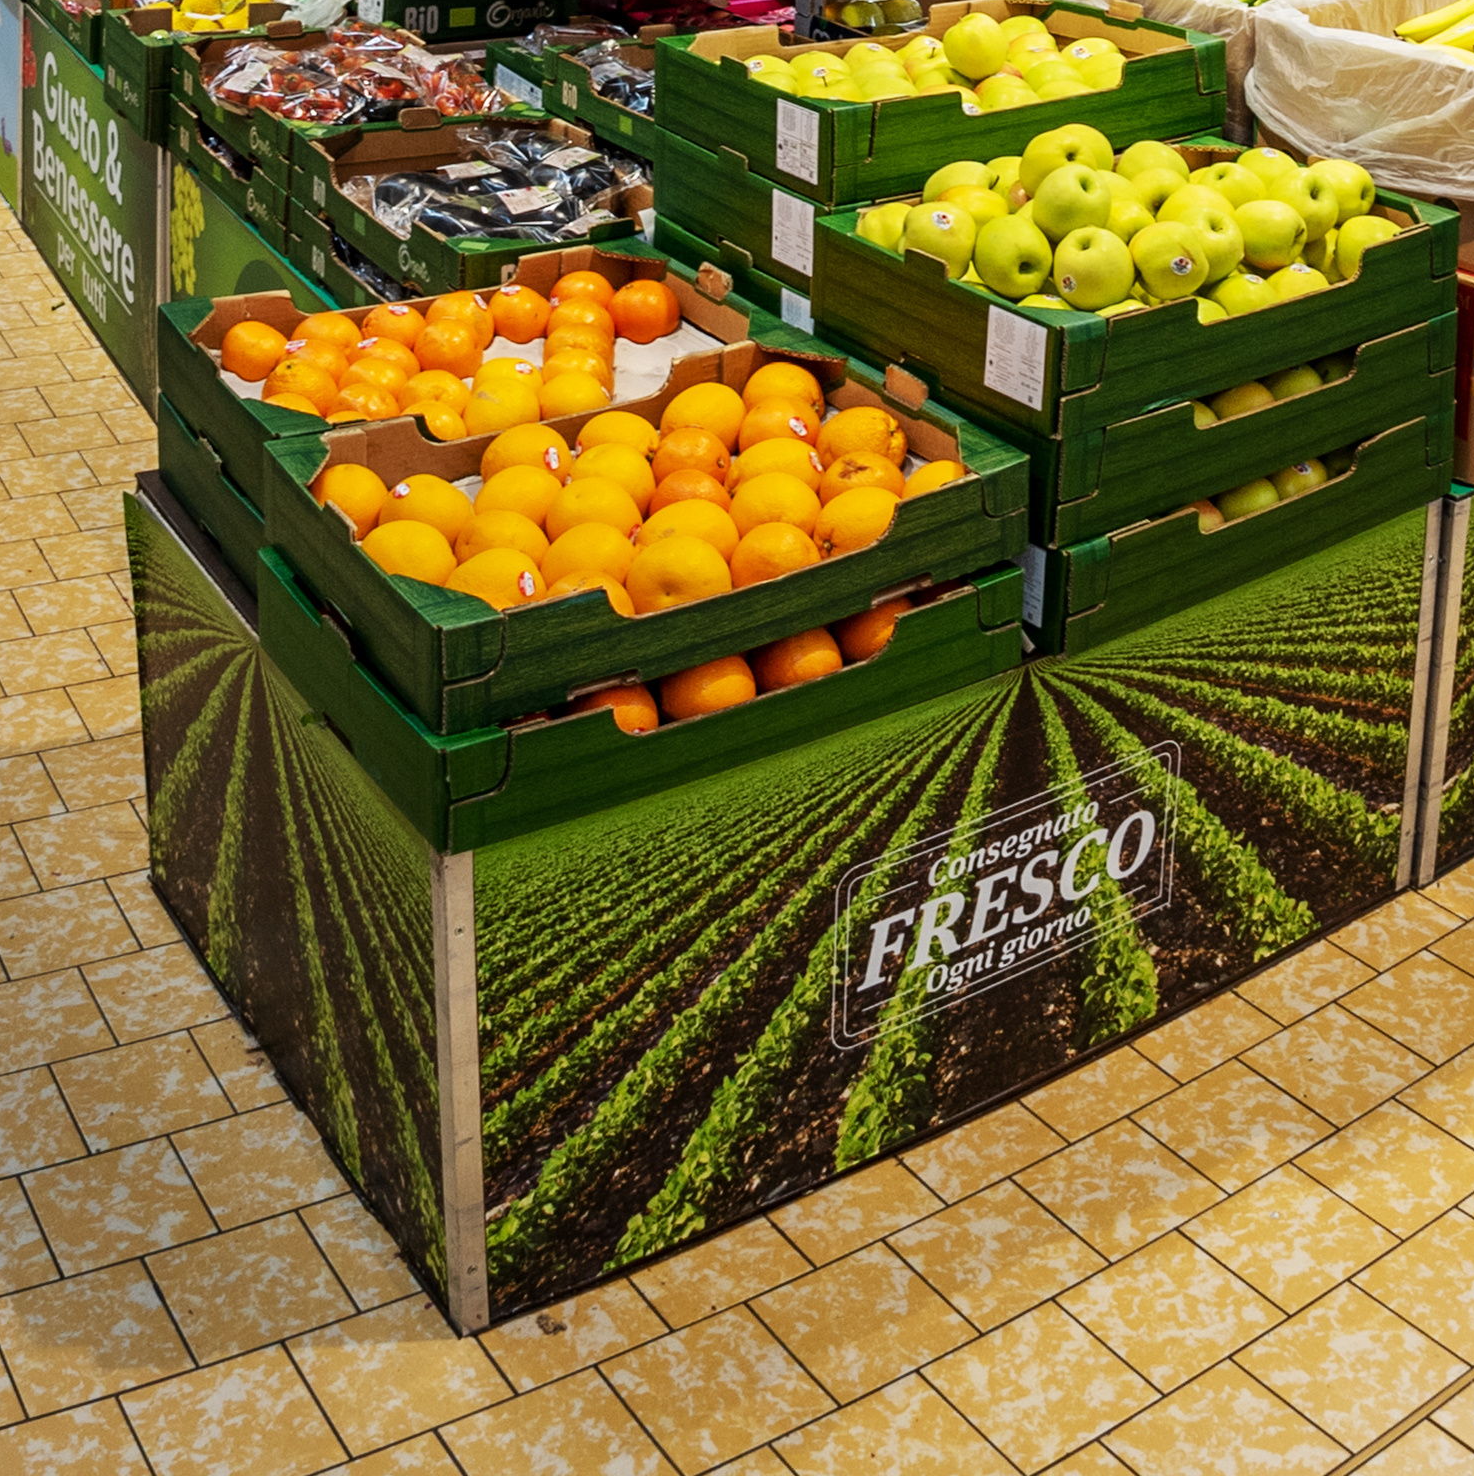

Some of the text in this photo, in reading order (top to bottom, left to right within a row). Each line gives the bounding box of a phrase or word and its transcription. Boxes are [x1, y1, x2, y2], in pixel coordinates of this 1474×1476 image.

[405, 0, 555, 34] BiO Organic
[43, 51, 123, 206] Gusto &
[32, 109, 135, 304] Benessere
[57, 232, 106, 323] per tutti
[927, 801, 1100, 887] Consegnato
[856, 809, 1156, 993] FRESCO
[926, 906, 1091, 993] Ogni giorno
